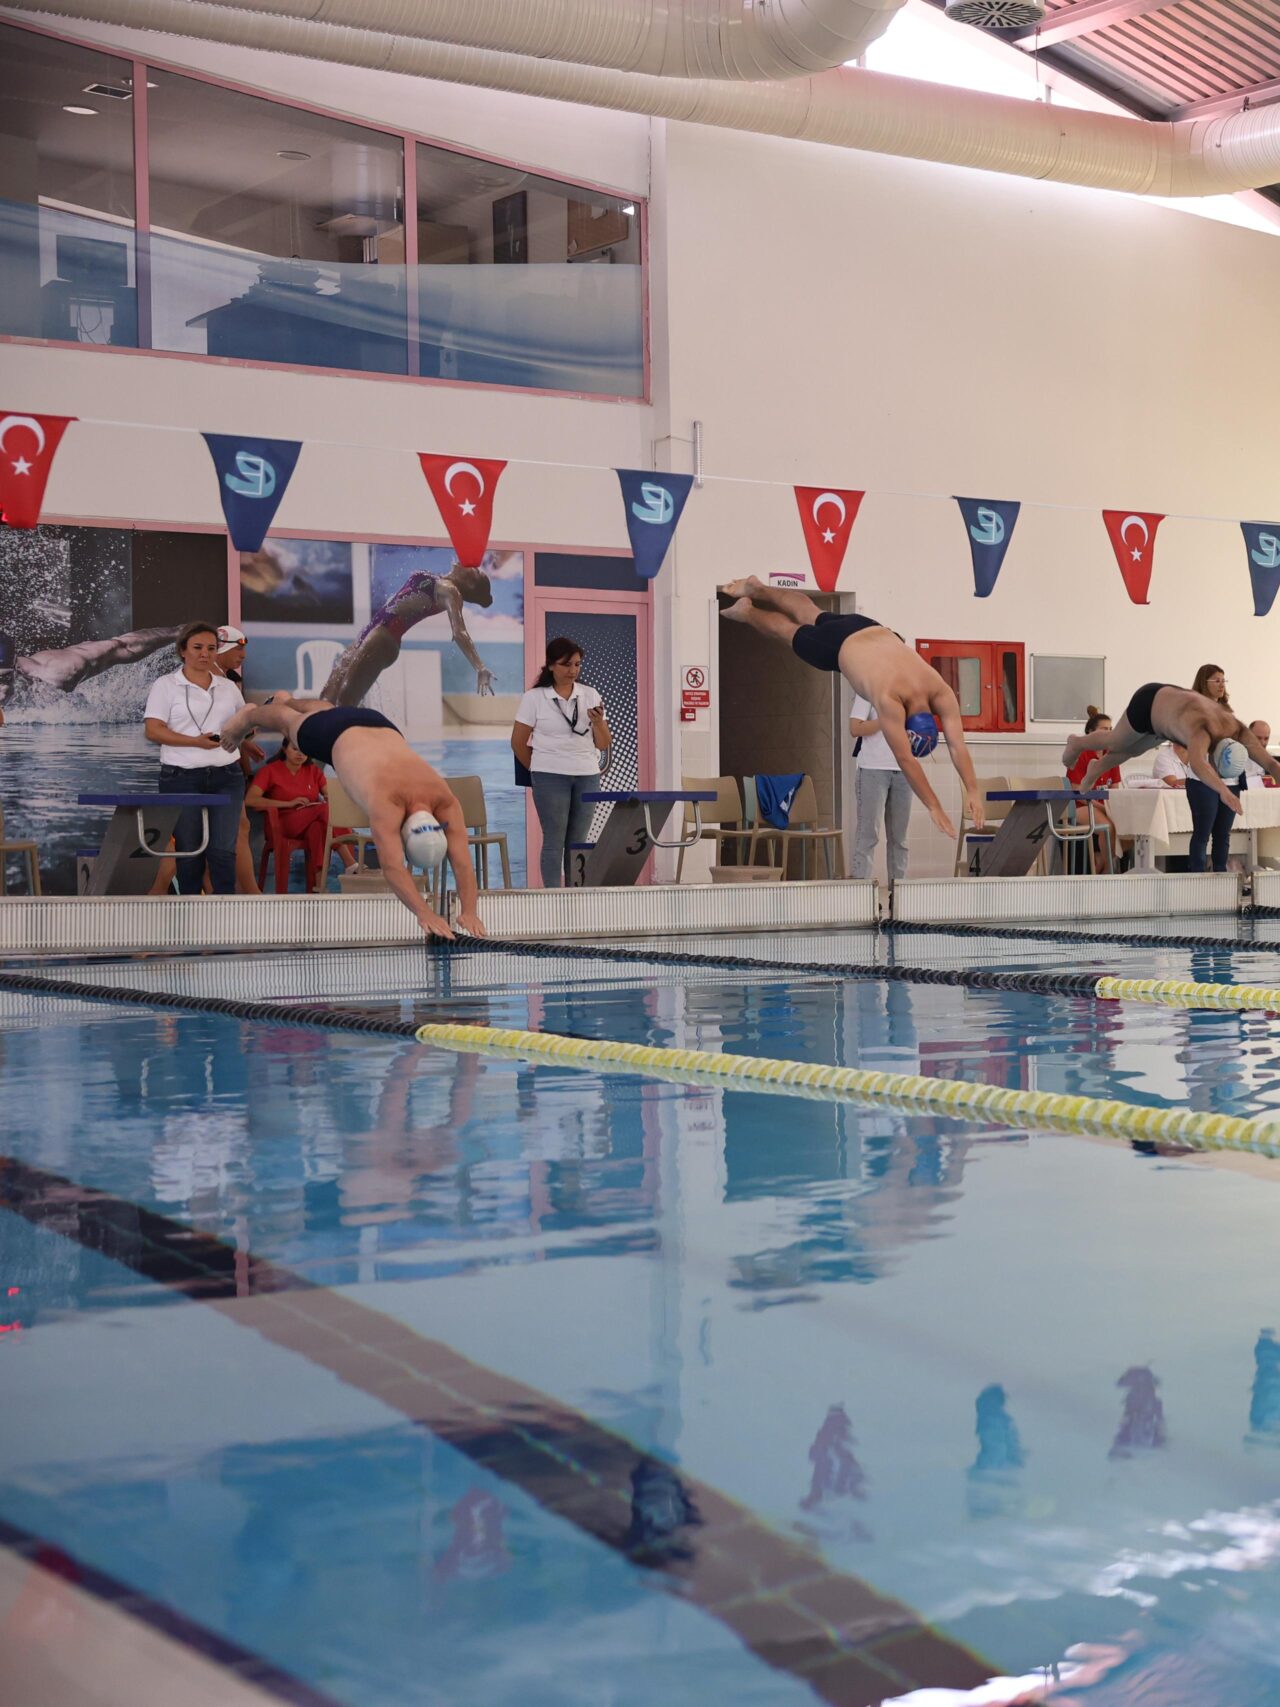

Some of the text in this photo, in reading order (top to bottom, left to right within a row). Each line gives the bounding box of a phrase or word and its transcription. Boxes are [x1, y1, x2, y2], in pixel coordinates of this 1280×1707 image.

[777, 579, 799, 587] KADIN
[129, 828, 161, 858] 2
[626, 827, 648, 855] 3
[1026, 820, 1049, 844] 4
[574, 853, 585, 887] 3
[969, 847, 981, 877] 4
